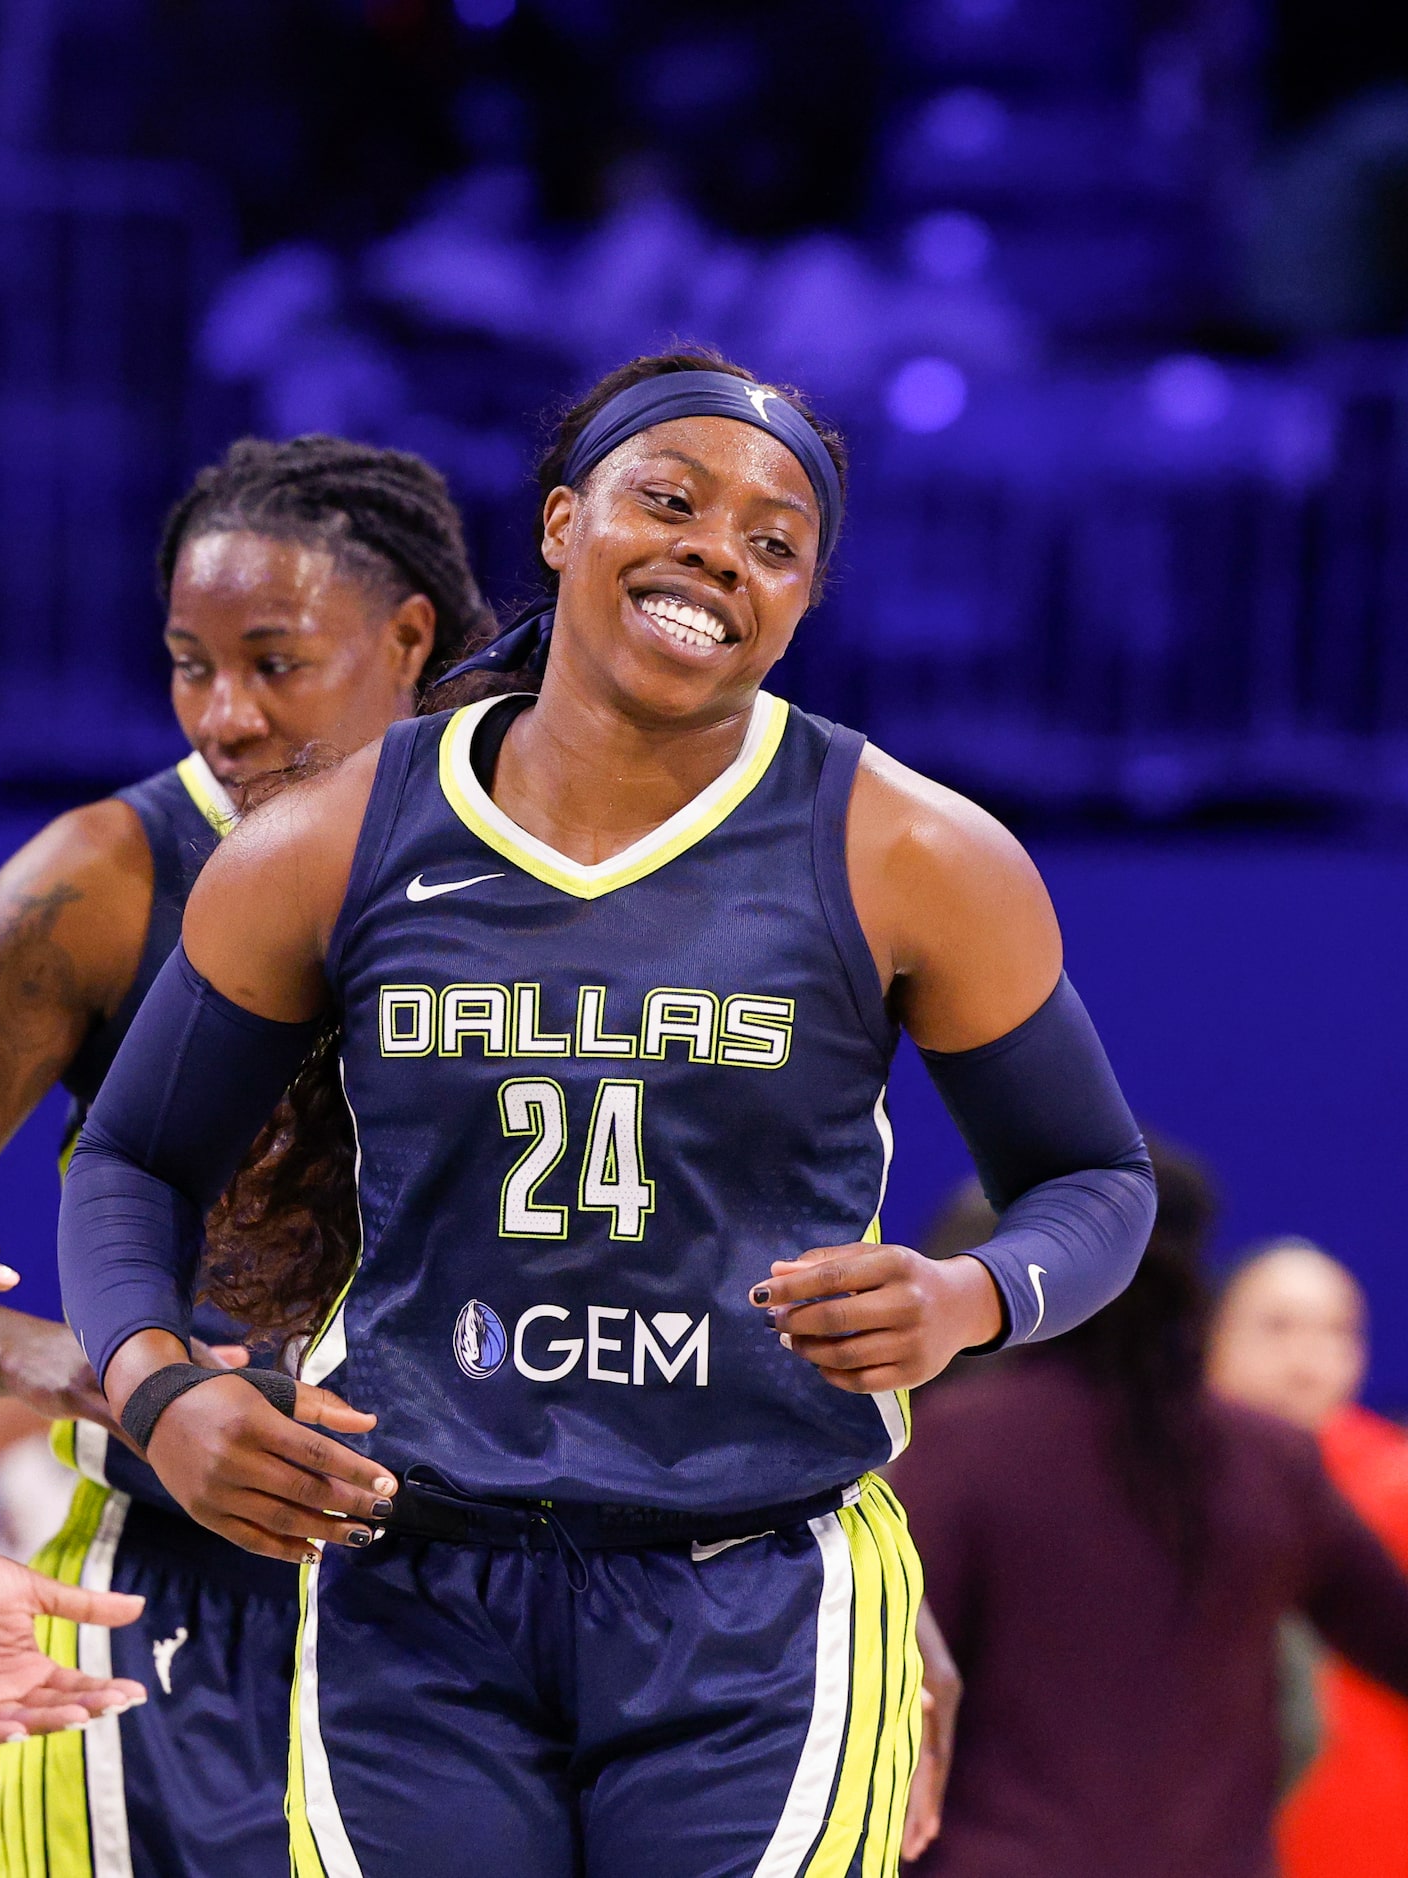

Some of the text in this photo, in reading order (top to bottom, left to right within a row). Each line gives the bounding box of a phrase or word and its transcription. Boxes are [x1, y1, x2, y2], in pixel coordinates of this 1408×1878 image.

[378, 983, 795, 1069] DALLAS
[497, 1076, 656, 1241] 24
[513, 1304, 710, 1387] GEM
